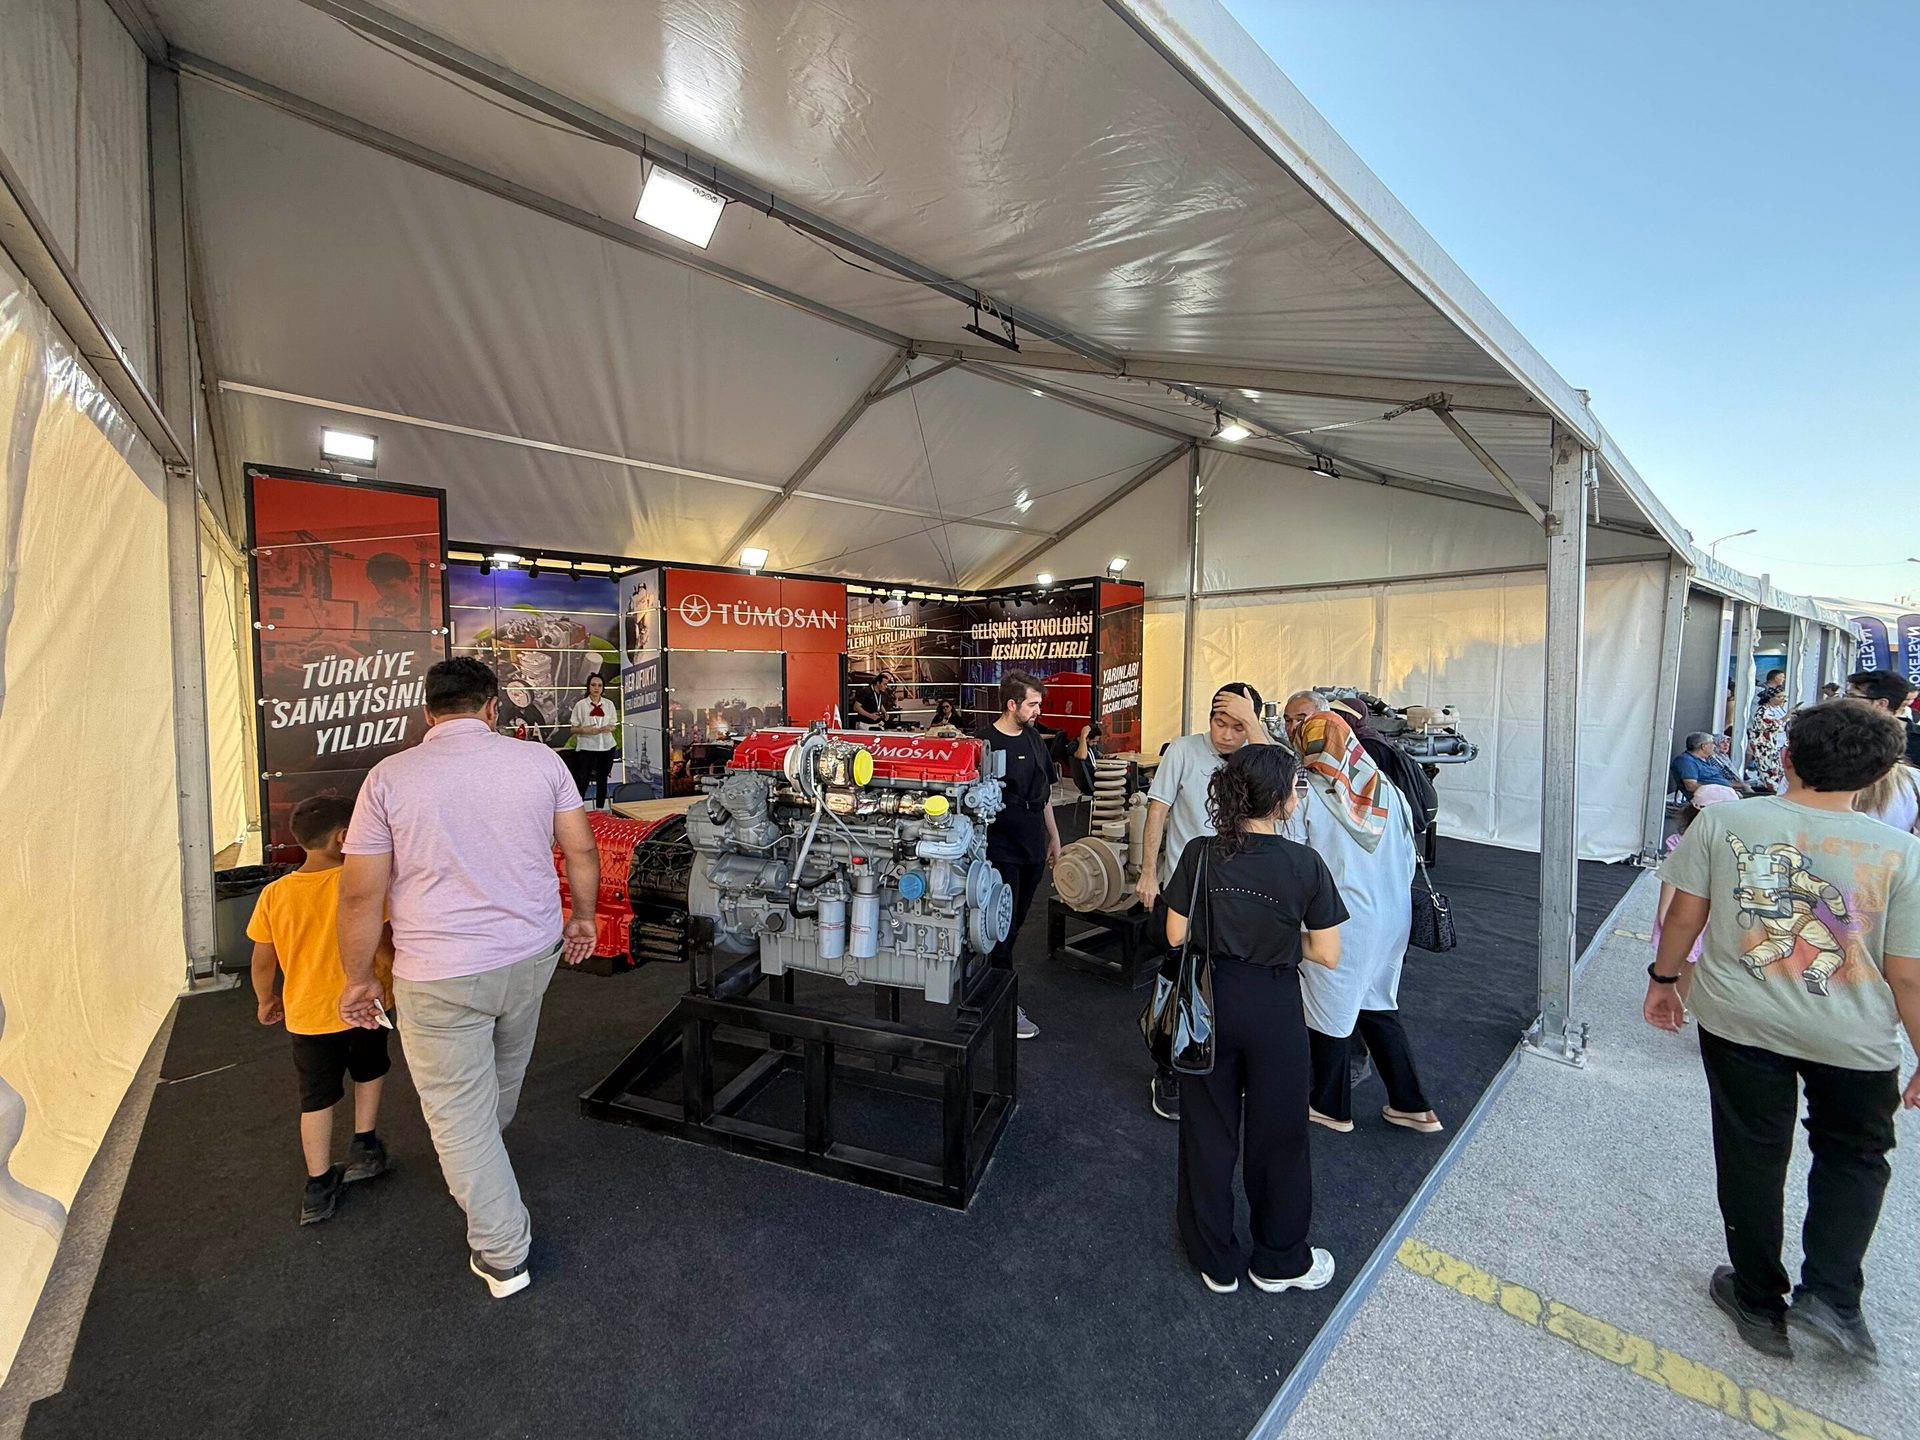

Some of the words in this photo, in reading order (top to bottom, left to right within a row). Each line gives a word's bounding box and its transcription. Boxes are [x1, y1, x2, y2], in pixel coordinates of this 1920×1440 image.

[717, 600, 837, 629] TÜMOSAN
[853, 618, 881, 635] MARİN
[883, 615, 911, 628] MOTOR
[971, 617, 1018, 642] GELİŞMİŞ
[1020, 610, 1093, 637] TEKNOLOJİSİ
[848, 635, 873, 649] LERİN
[900, 623, 928, 640] HAKİMİ
[991, 638, 1048, 660] KESİNTİSİZ
[1048, 636, 1089, 658] ENERJİ
[303, 649, 415, 690] TÜRKİYE
[1103, 661, 1139, 685] YARINLARI
[1102, 679, 1139, 702] BUGÜNDEN
[316, 715, 408, 756] YILDIZI
[871, 744, 953, 760] ÜMOSAN
